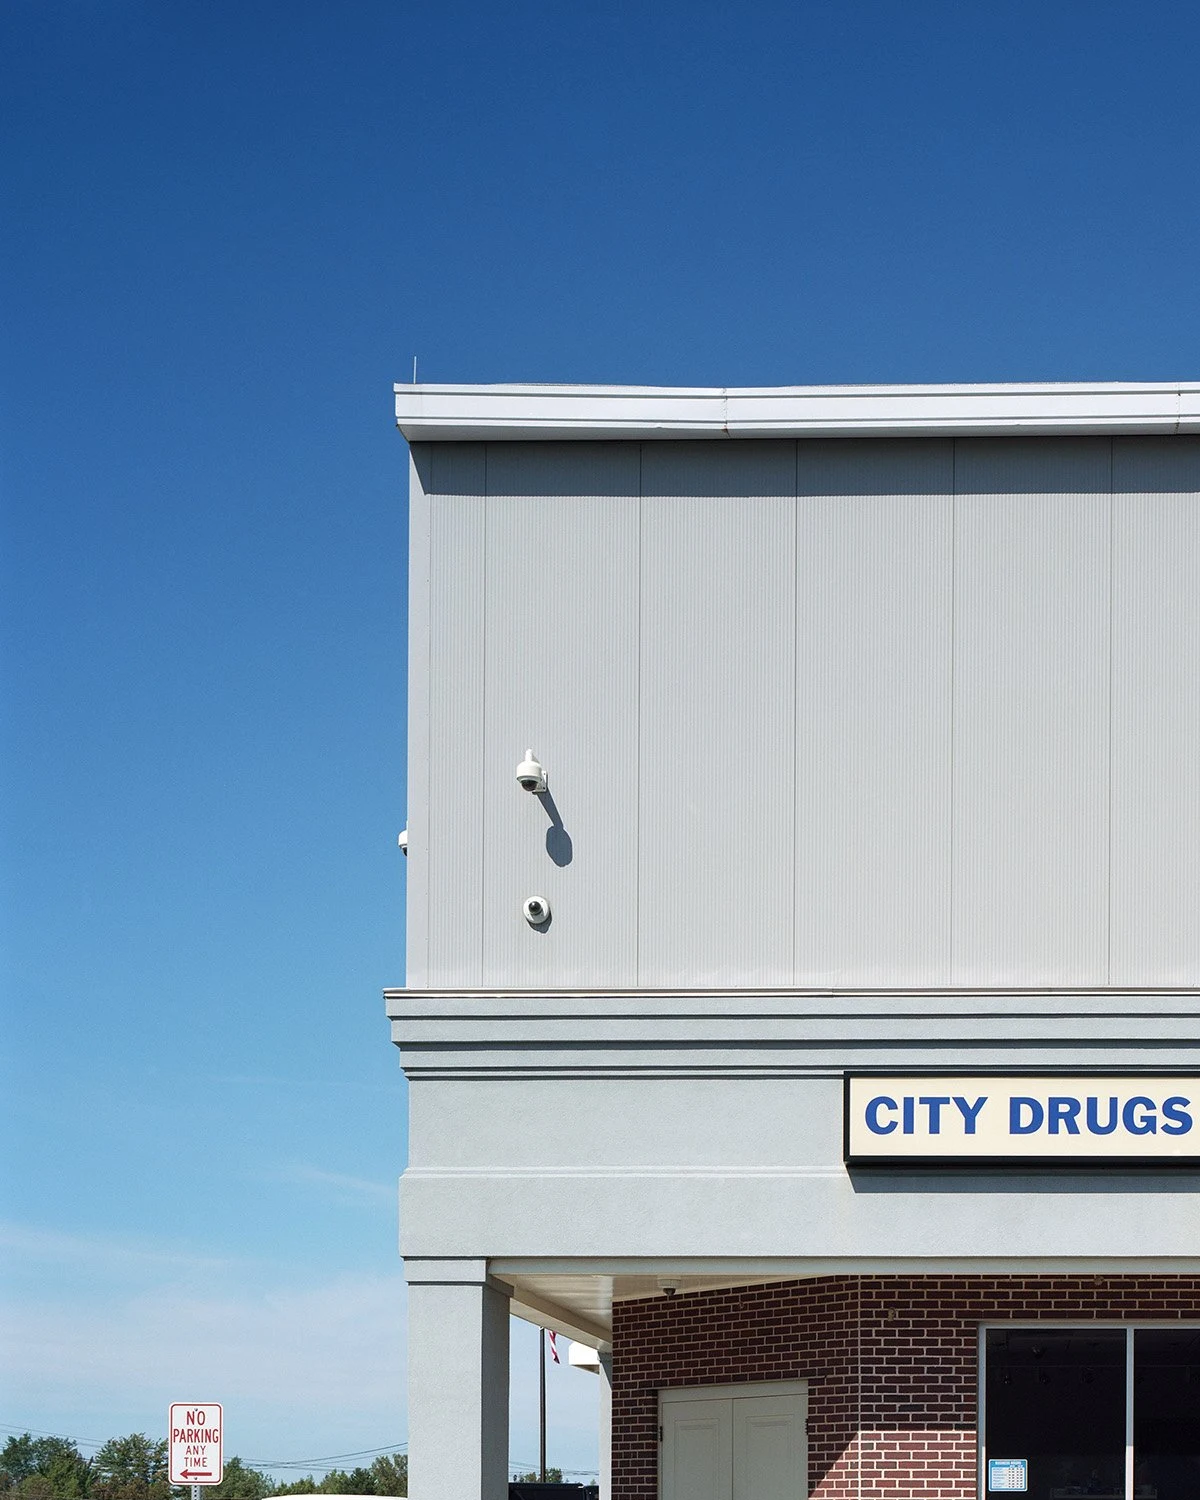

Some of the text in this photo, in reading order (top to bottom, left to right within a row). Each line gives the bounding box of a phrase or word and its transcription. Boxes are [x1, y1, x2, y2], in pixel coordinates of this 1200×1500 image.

[864, 1095, 1194, 1136] CITY DRUGS
[186, 1410, 206, 1426] NO
[173, 1428, 219, 1443] PARKING
[185, 1445, 206, 1455] ANY
[184, 1457, 208, 1467] TIME
